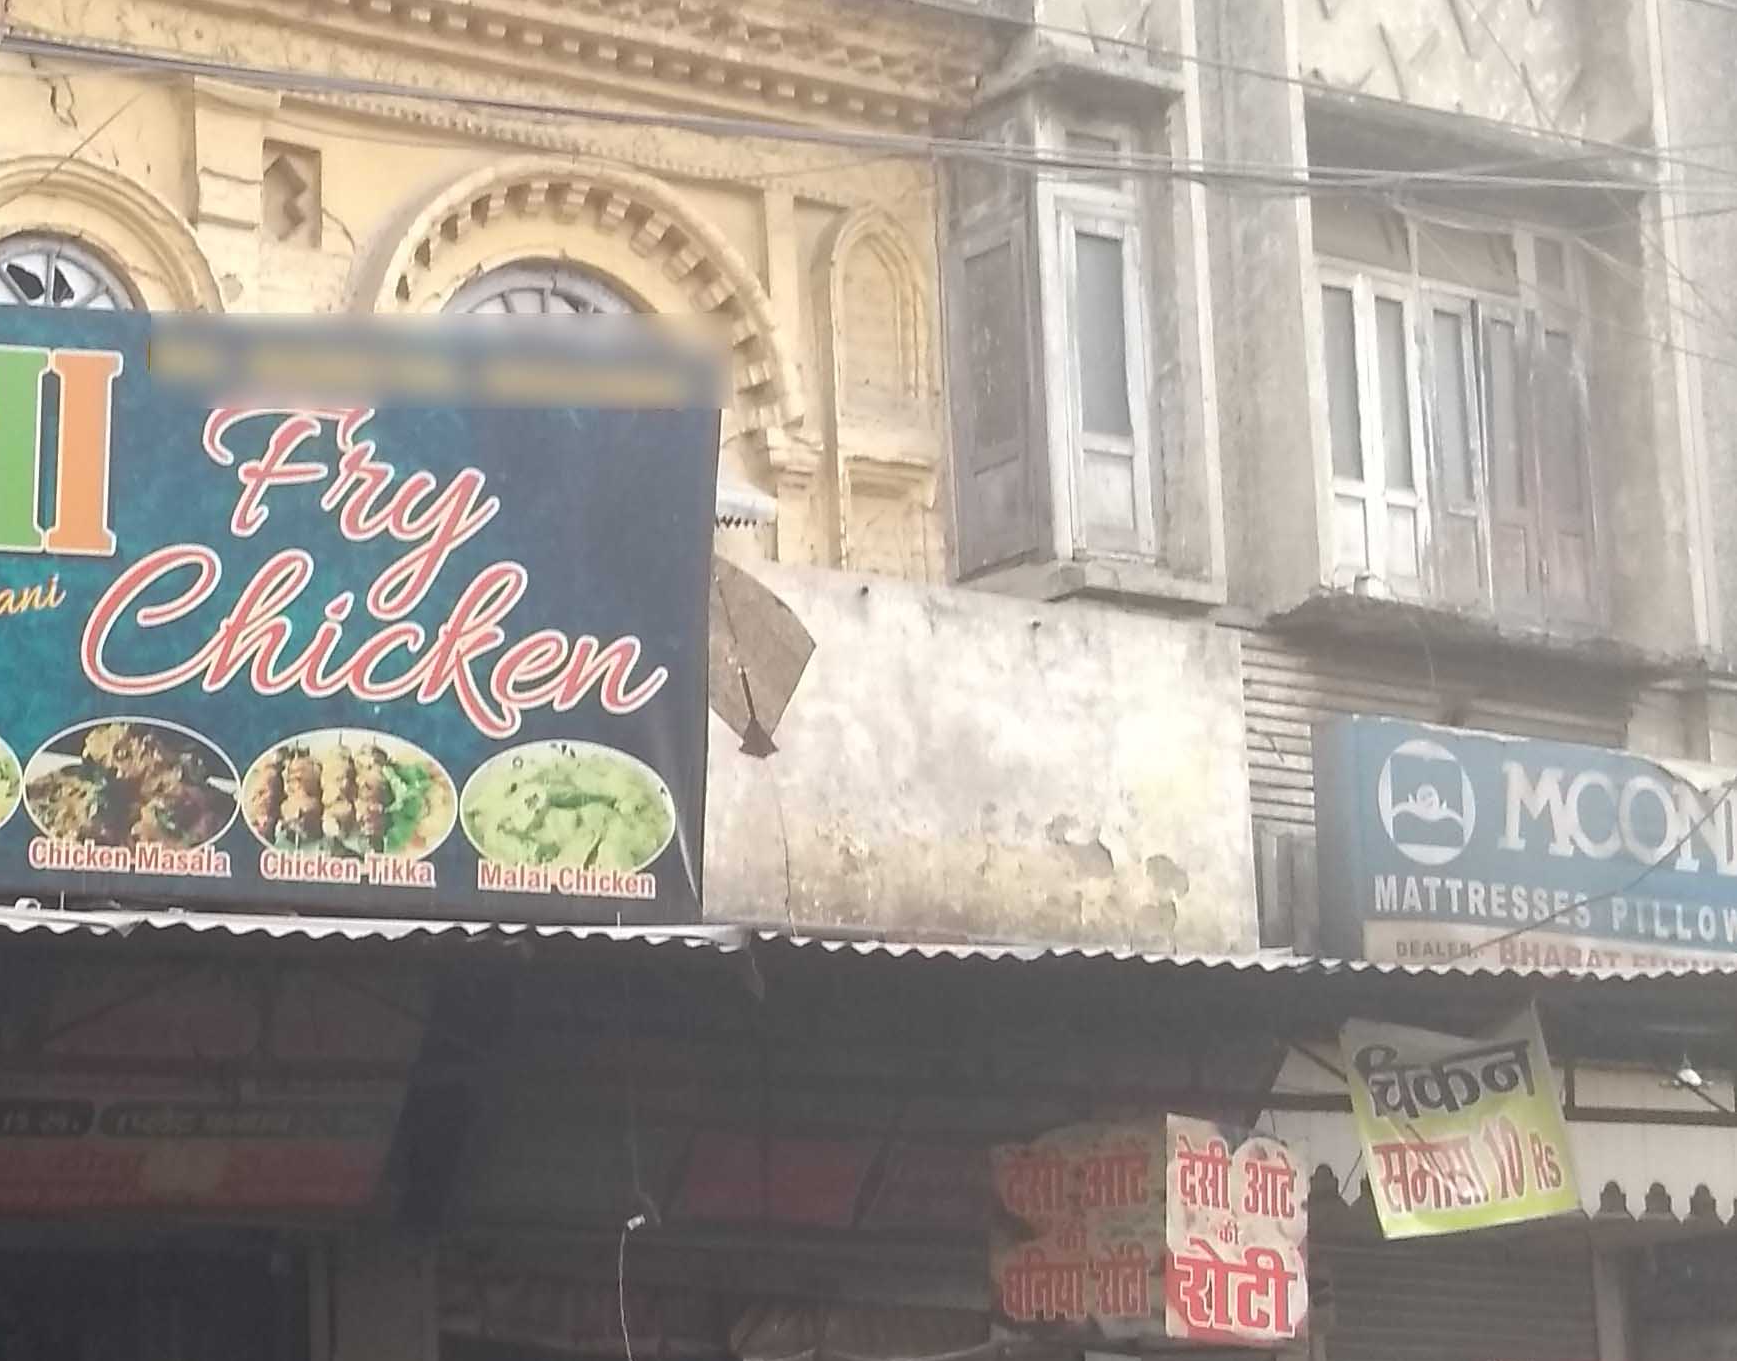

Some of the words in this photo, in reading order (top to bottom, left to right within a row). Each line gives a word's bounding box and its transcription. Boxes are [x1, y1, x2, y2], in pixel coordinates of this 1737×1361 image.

[203, 406, 500, 620] Fry
[81, 543, 668, 738] Chicken
[1373, 874, 1593, 931] MATTRESSES
[1498, 940, 1623, 970] BHARAT
[1355, 1039, 1536, 1119] चिकन
[1177, 1133, 1232, 1212] देसी
[1243, 1151, 1297, 1220] आटे
[1482, 1116, 1526, 1201] 10
[1528, 1131, 1562, 1191] Rs
[1216, 1219, 1243, 1246] की
[1173, 1236, 1299, 1337] रोटी
